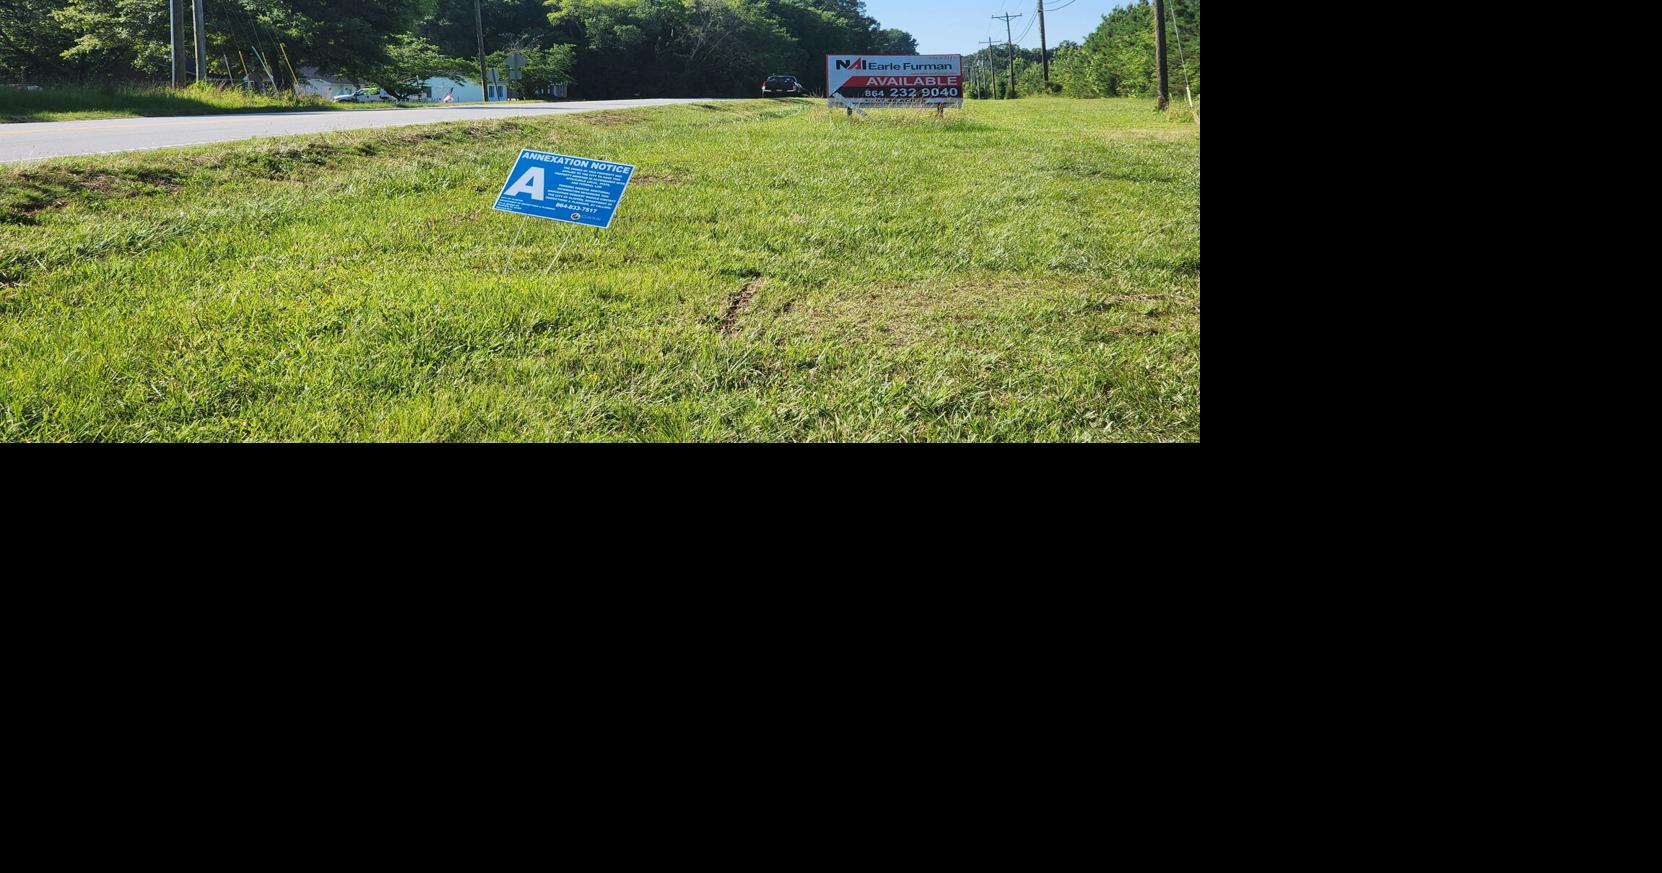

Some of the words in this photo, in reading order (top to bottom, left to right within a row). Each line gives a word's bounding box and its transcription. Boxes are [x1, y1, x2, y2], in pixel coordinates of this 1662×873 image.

[836, 57, 866, 70] NAI
[868, 62, 901, 71] Earle
[903, 62, 952, 71] Furman
[867, 77, 957, 86] AVAILABLE
[890, 88, 917, 97] 232
[922, 88, 958, 97] 9040
[522, 151, 589, 168] ANNEXATION
[591, 162, 631, 174] NOTICE
[504, 166, 545, 201] A
